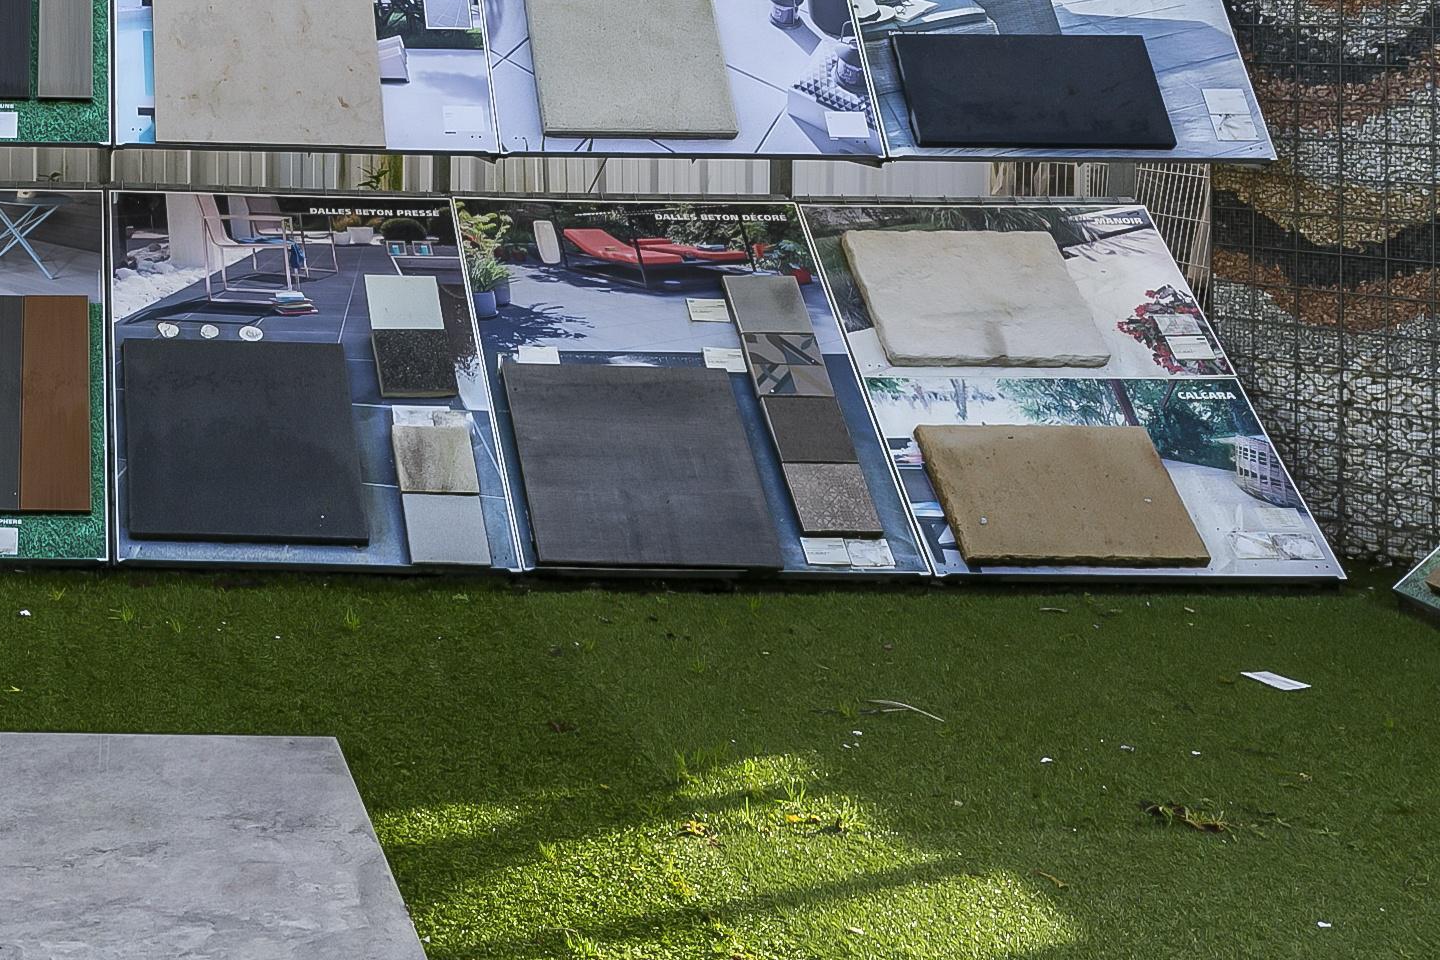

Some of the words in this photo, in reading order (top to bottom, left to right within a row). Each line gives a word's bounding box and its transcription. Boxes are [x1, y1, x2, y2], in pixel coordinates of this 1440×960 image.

[309, 207, 352, 216] DALLES
[396, 208, 440, 217] PRESSÉ
[654, 213, 698, 222] DALLES
[1094, 217, 1144, 225] MANOIR
[1177, 391, 1237, 400] CALCARA
